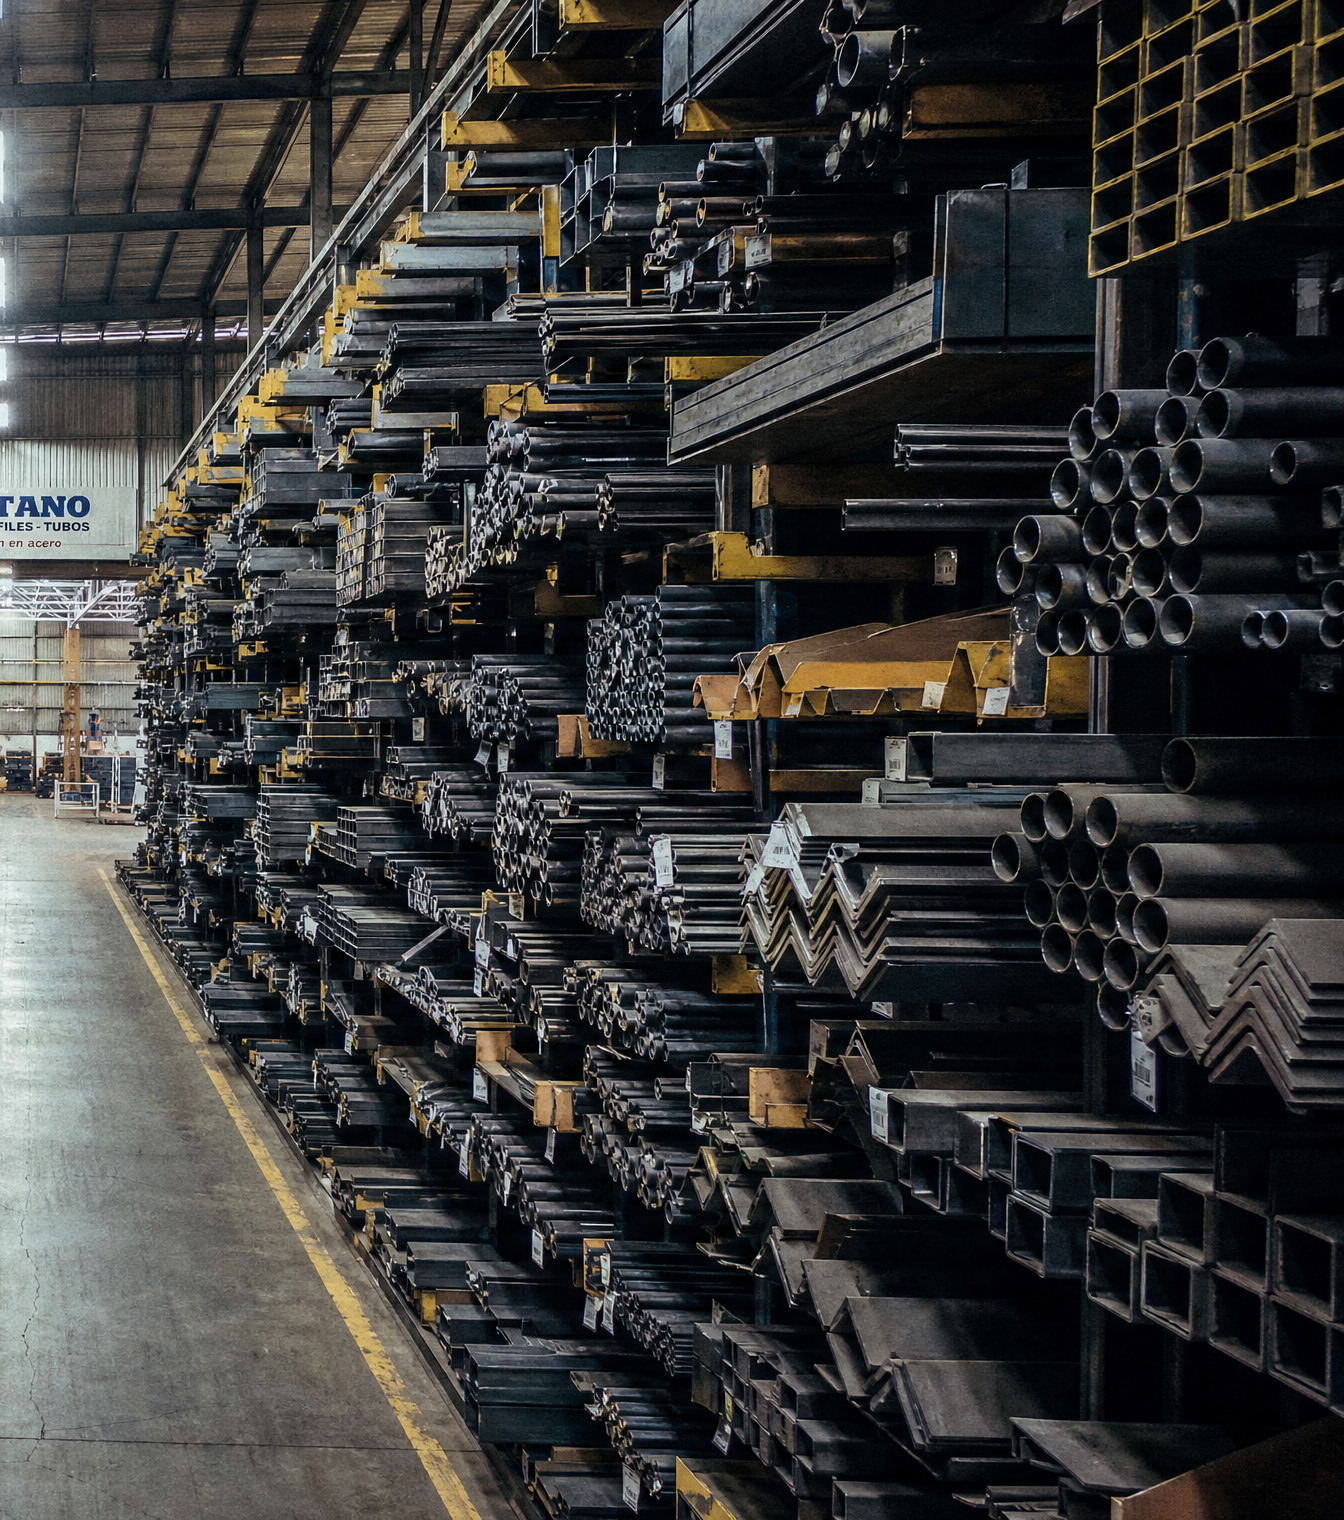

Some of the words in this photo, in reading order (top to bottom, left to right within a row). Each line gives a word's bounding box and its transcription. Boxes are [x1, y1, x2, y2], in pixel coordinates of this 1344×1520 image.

[44, 521, 90, 532] TUBOS
[9, 540, 23, 548] en
[27, 540, 62, 548] acero
